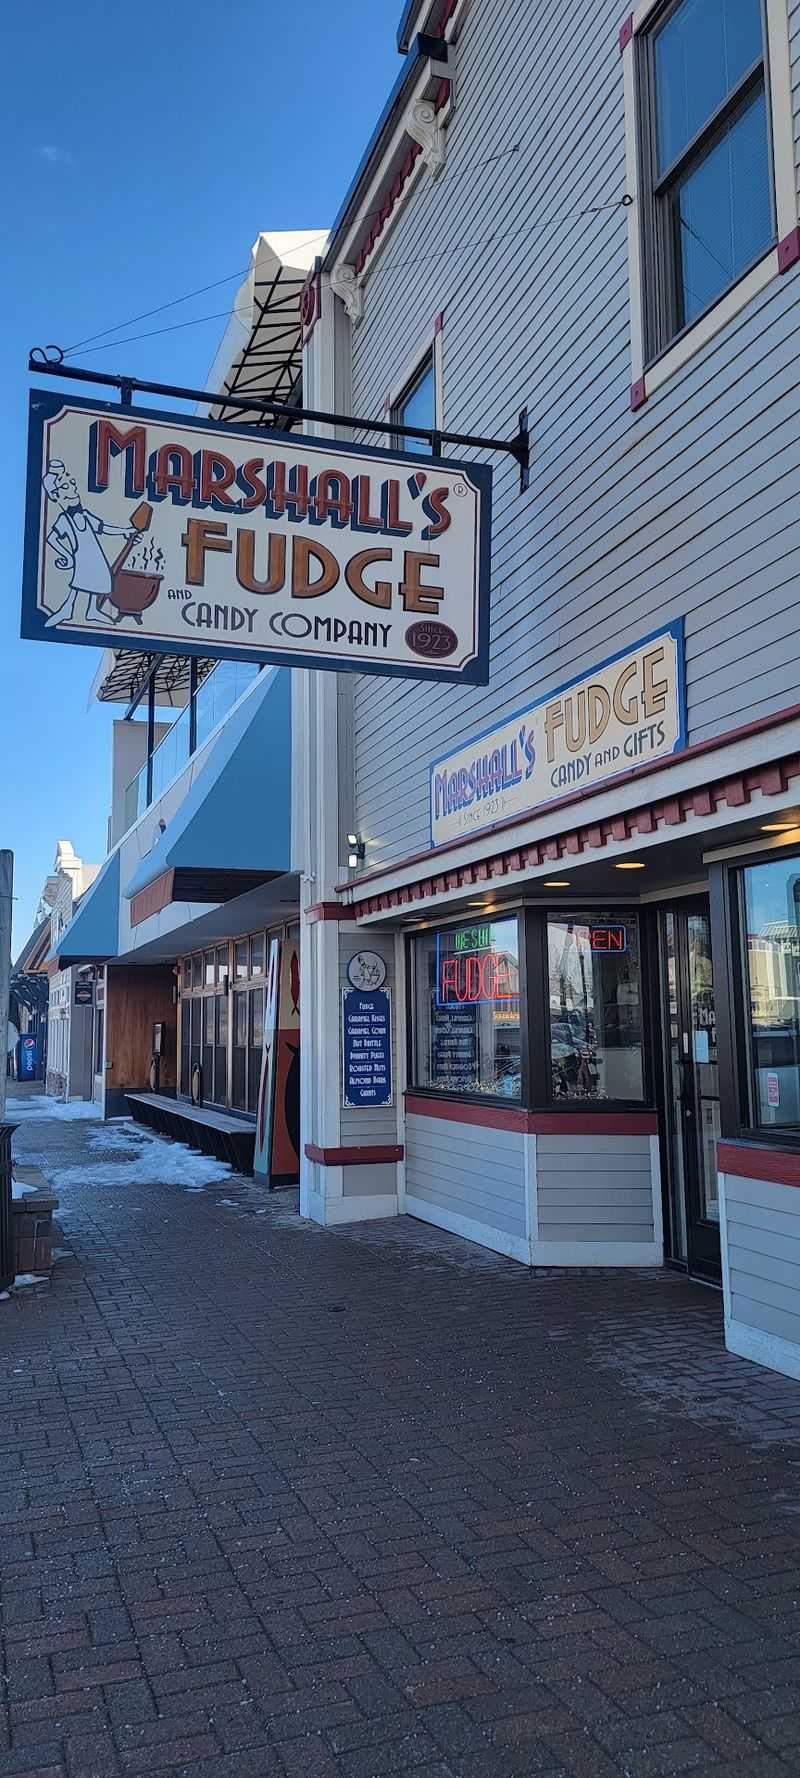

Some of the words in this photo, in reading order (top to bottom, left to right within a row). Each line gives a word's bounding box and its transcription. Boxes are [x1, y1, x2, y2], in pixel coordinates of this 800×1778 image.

[88, 419, 450, 541] MARSHALL'S
[168, 589, 193, 601] AND
[181, 517, 445, 615] FUDGE
[181, 601, 258, 633] CANDY
[269, 611, 393, 648] COMPANY
[412, 631, 451, 650] 1923
[415, 623, 446, 634] SINCE
[544, 647, 669, 764] FUDGE
[434, 725, 536, 820] MARSHALL'S
[551, 752, 592, 788] CANDY
[594, 746, 620, 768] AND
[624, 720, 666, 758] GIFTS
[442, 951, 512, 1002] FUDGE
